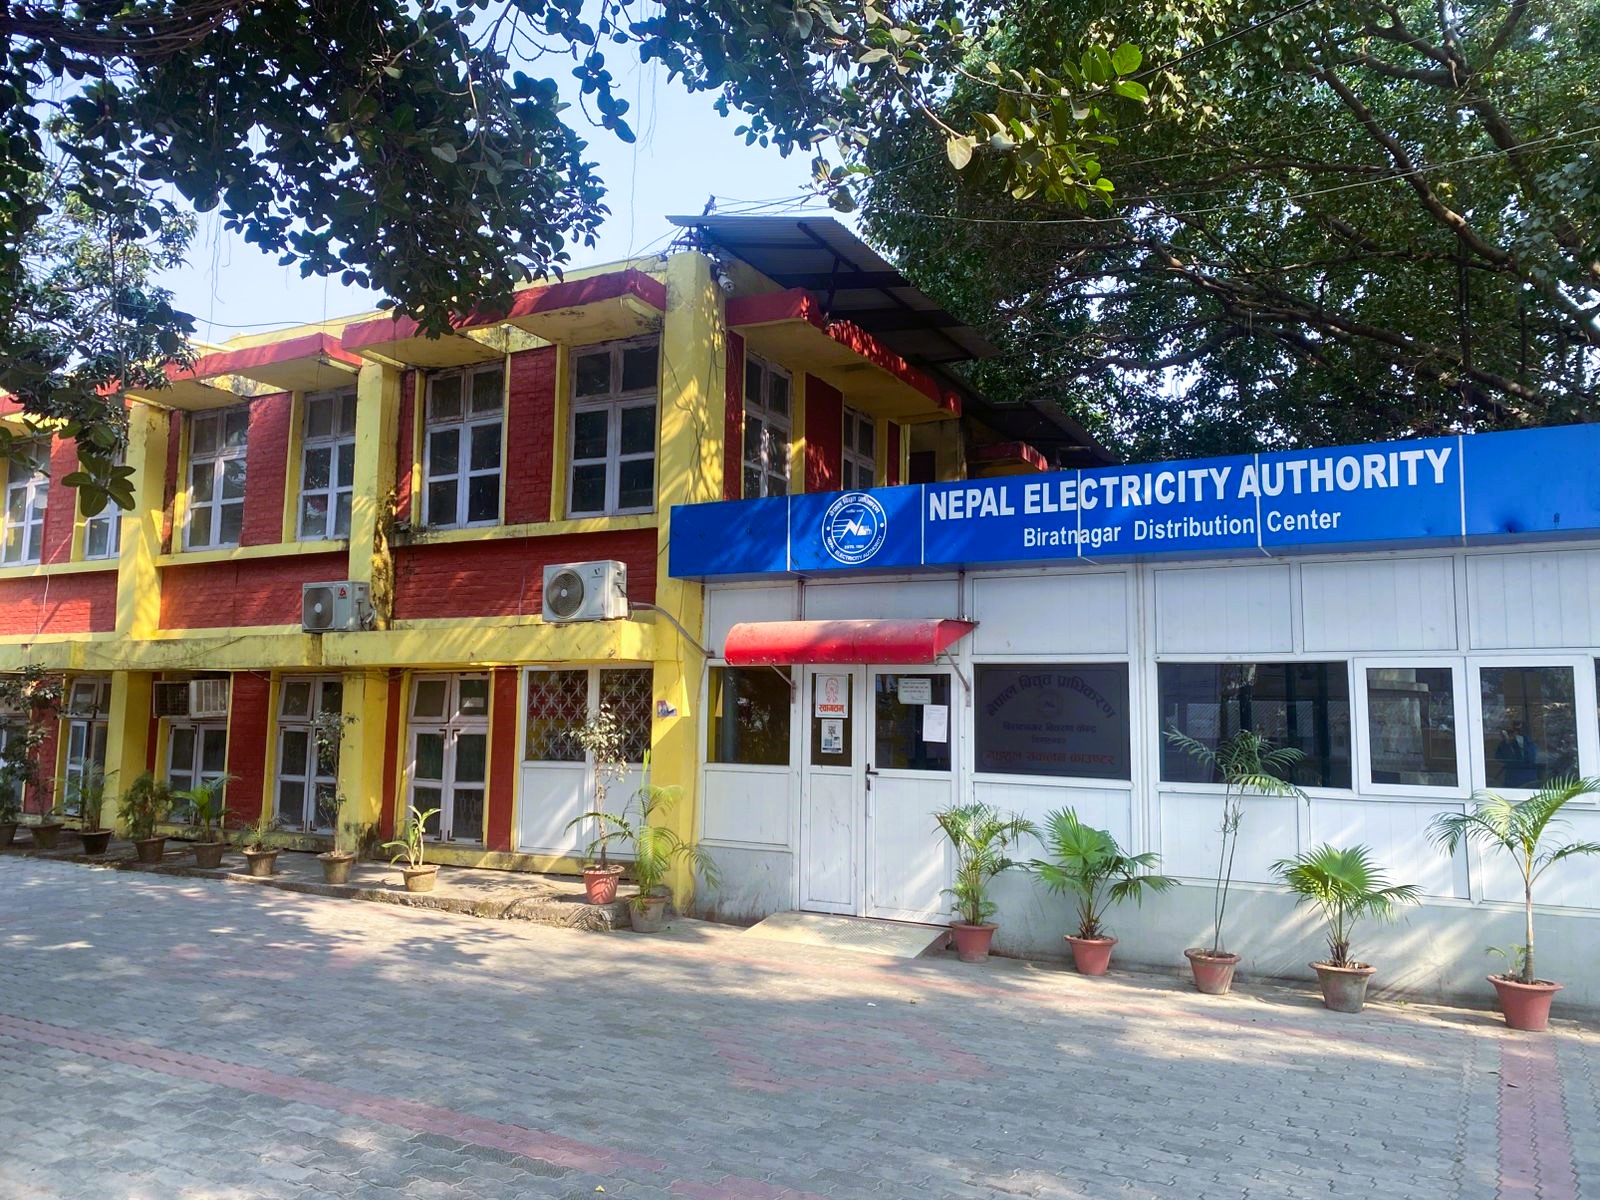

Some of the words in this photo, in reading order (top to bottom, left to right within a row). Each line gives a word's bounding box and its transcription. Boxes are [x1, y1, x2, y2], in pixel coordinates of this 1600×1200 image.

[929, 486, 1015, 521] NEPAL
[1024, 466, 1232, 514] ELECTRICITY
[1238, 447, 1452, 499] AUTHORITY
[1024, 526, 1122, 549] Biratnagar
[1134, 515, 1255, 541] Distribution
[1267, 510, 1341, 532] Center
